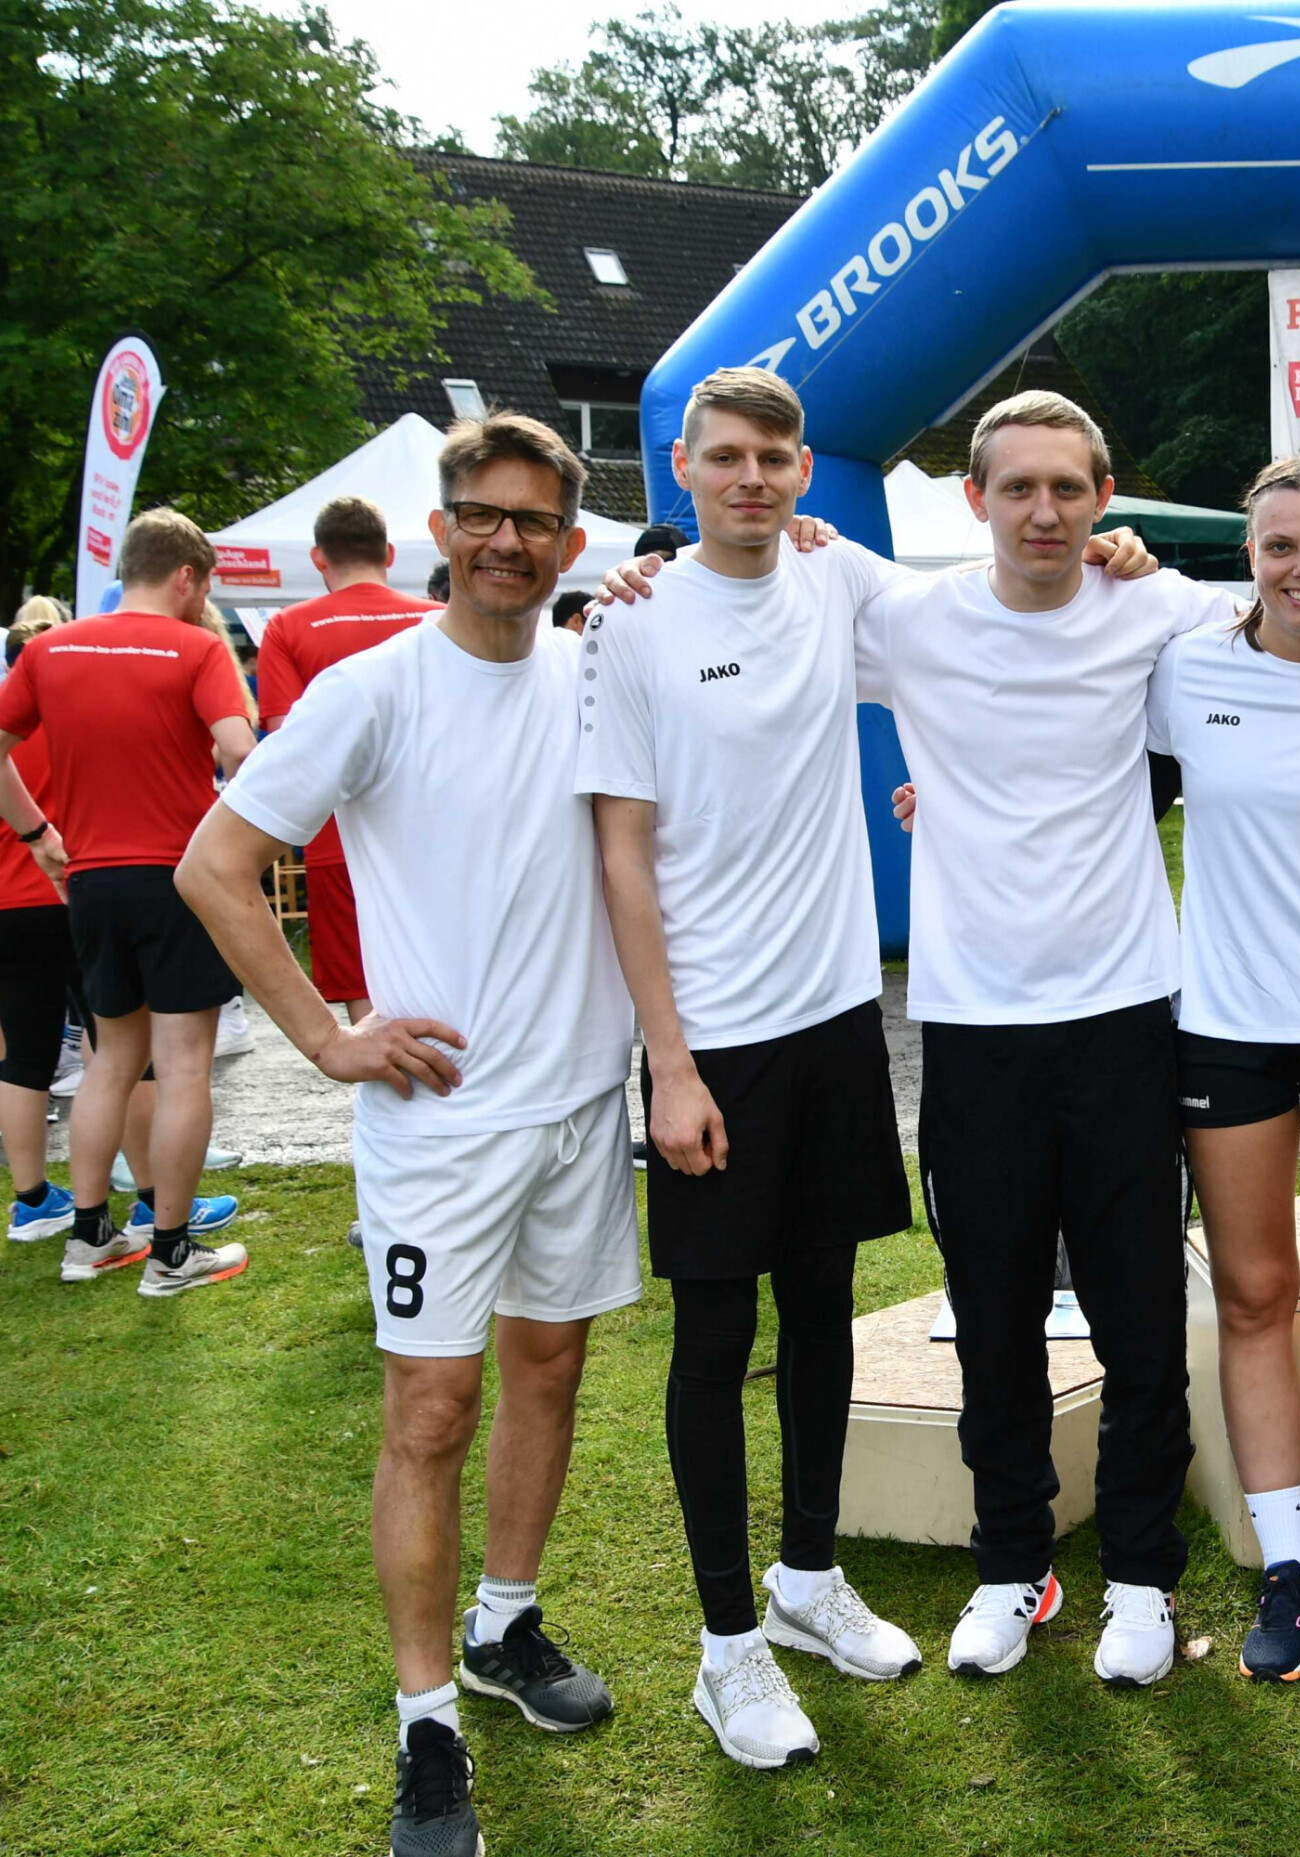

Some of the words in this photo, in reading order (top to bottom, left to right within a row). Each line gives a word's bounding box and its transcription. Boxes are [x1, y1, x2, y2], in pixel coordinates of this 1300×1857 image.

[795, 114, 1020, 351] BROOKS
[700, 662, 741, 683] JAKO
[1206, 712, 1241, 726] JAKO
[386, 1243, 427, 1319] 8
